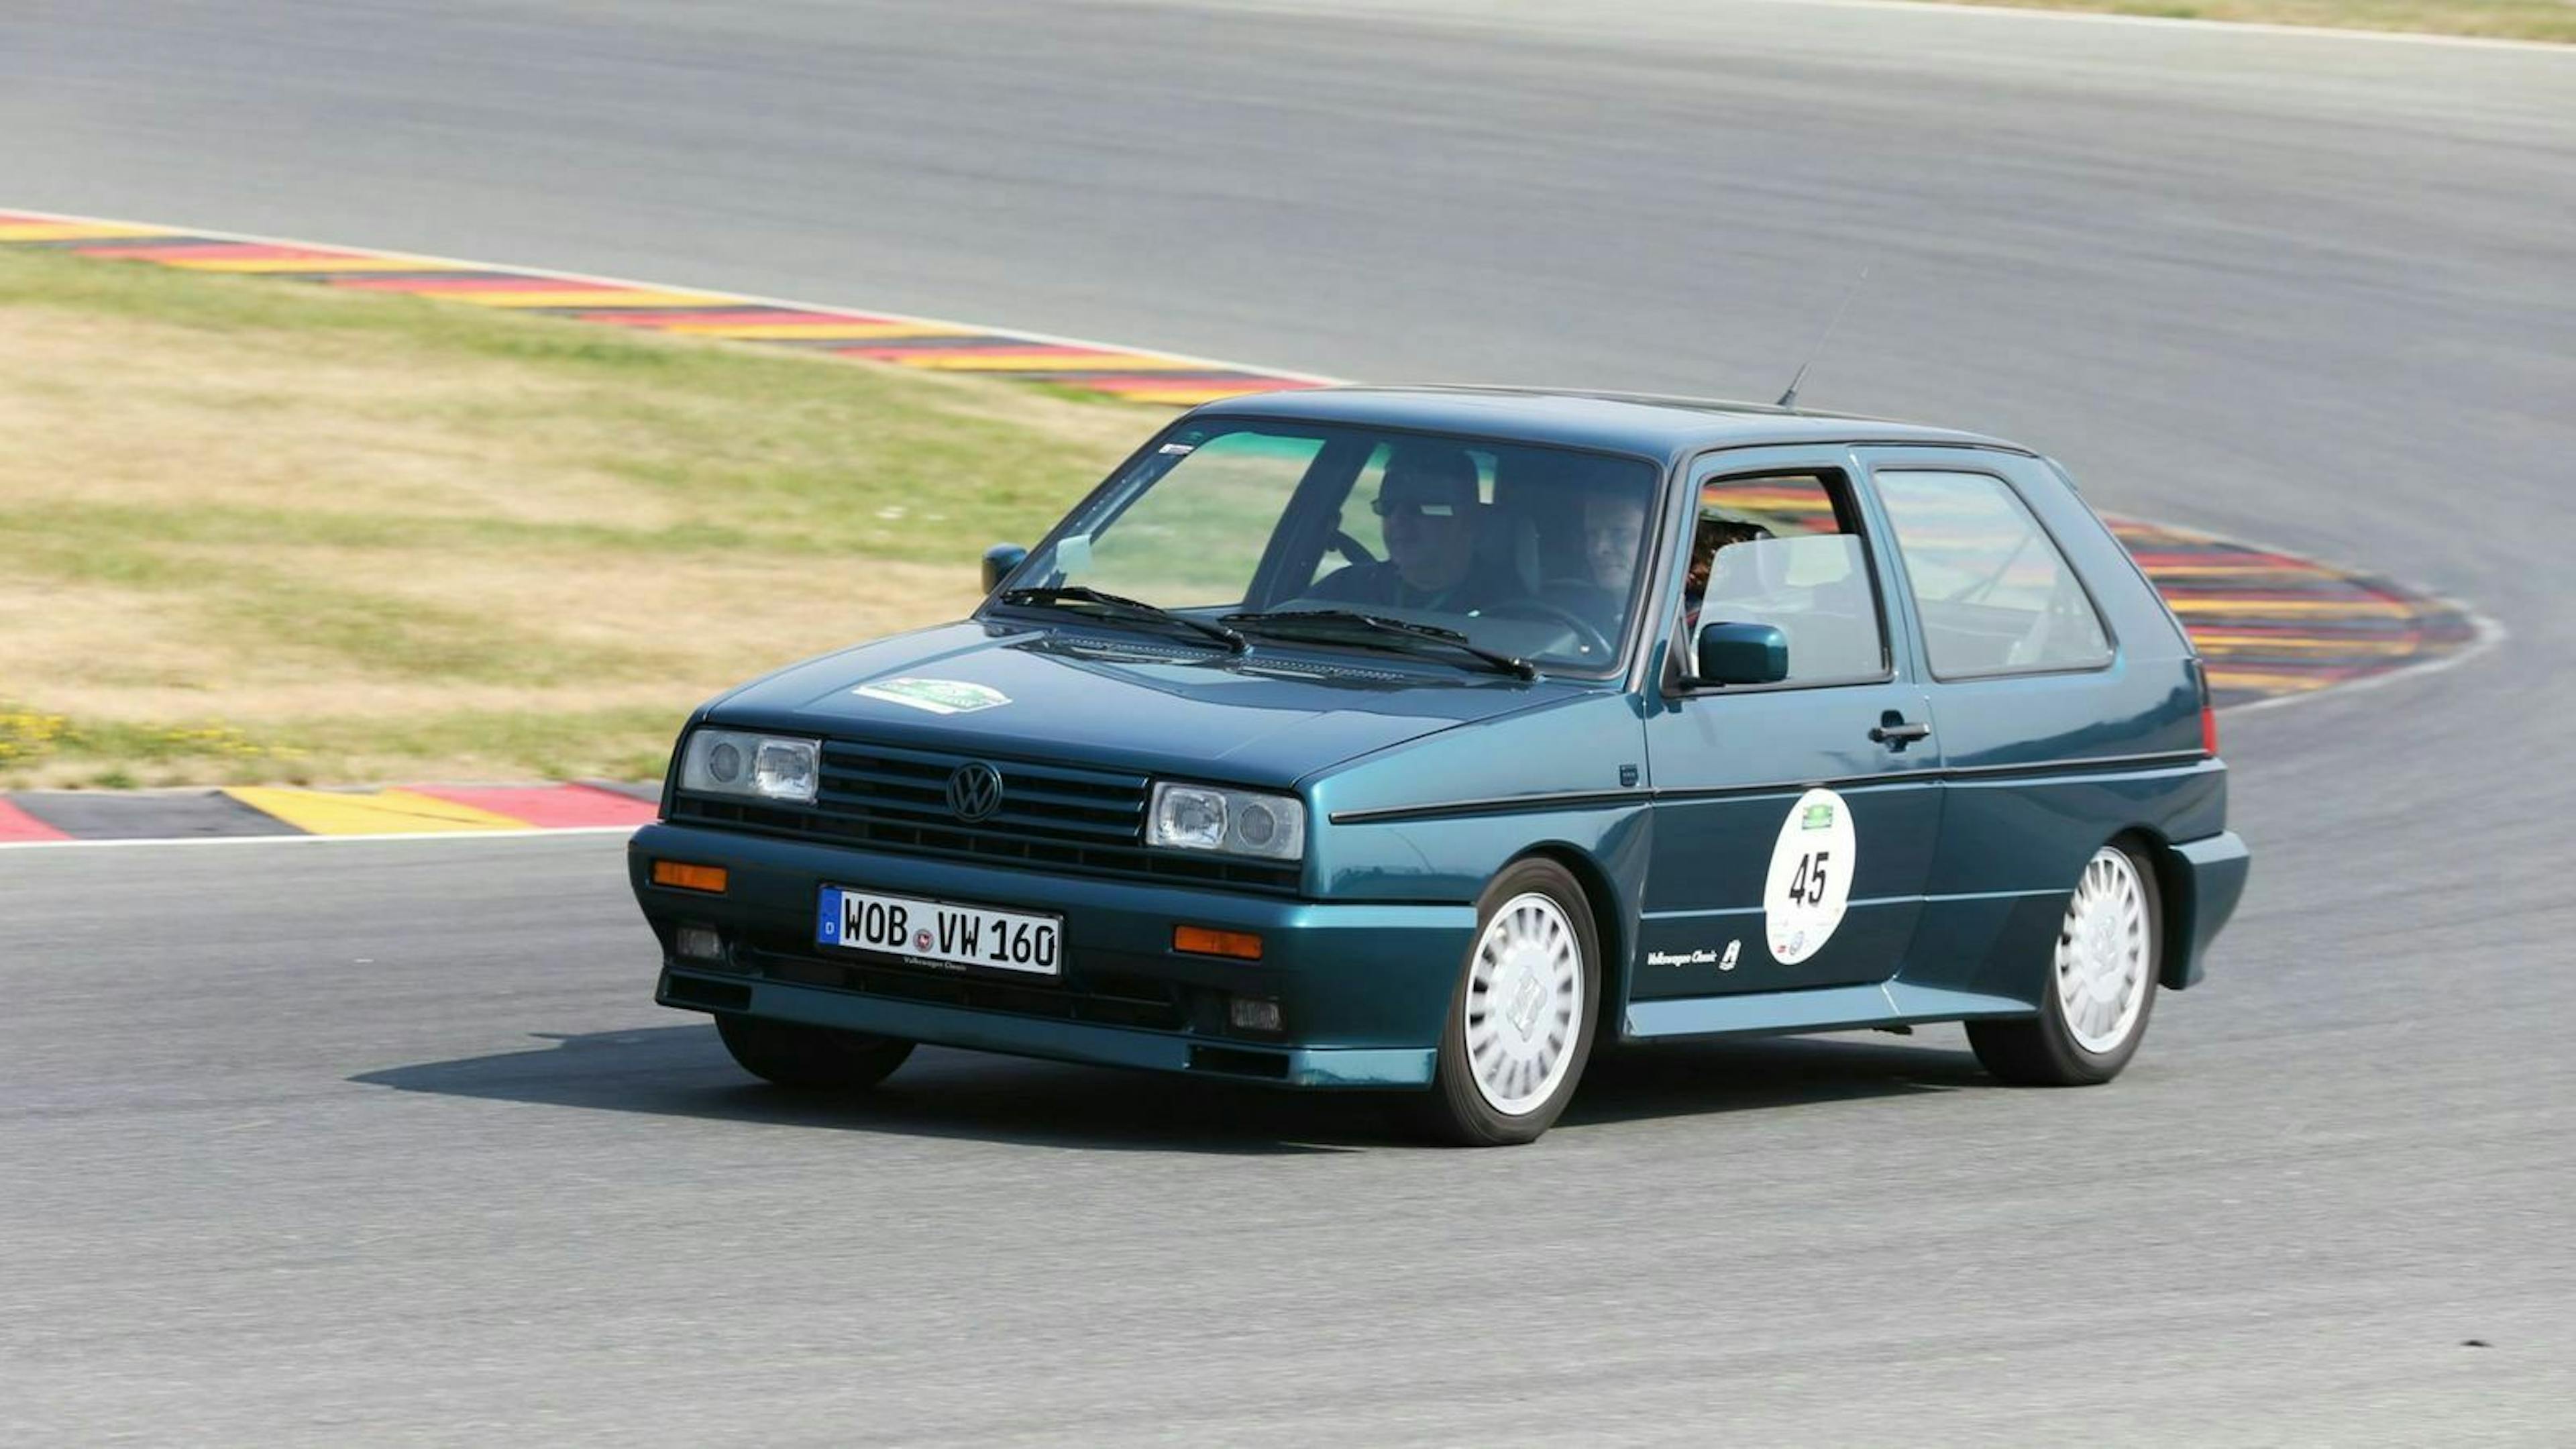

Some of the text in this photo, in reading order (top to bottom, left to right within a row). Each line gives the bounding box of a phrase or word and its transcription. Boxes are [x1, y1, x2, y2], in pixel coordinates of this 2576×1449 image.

[951, 763, 1000, 818] VW
[1789, 851, 1829, 908] 45
[845, 898, 1056, 967] WOB VW 160
